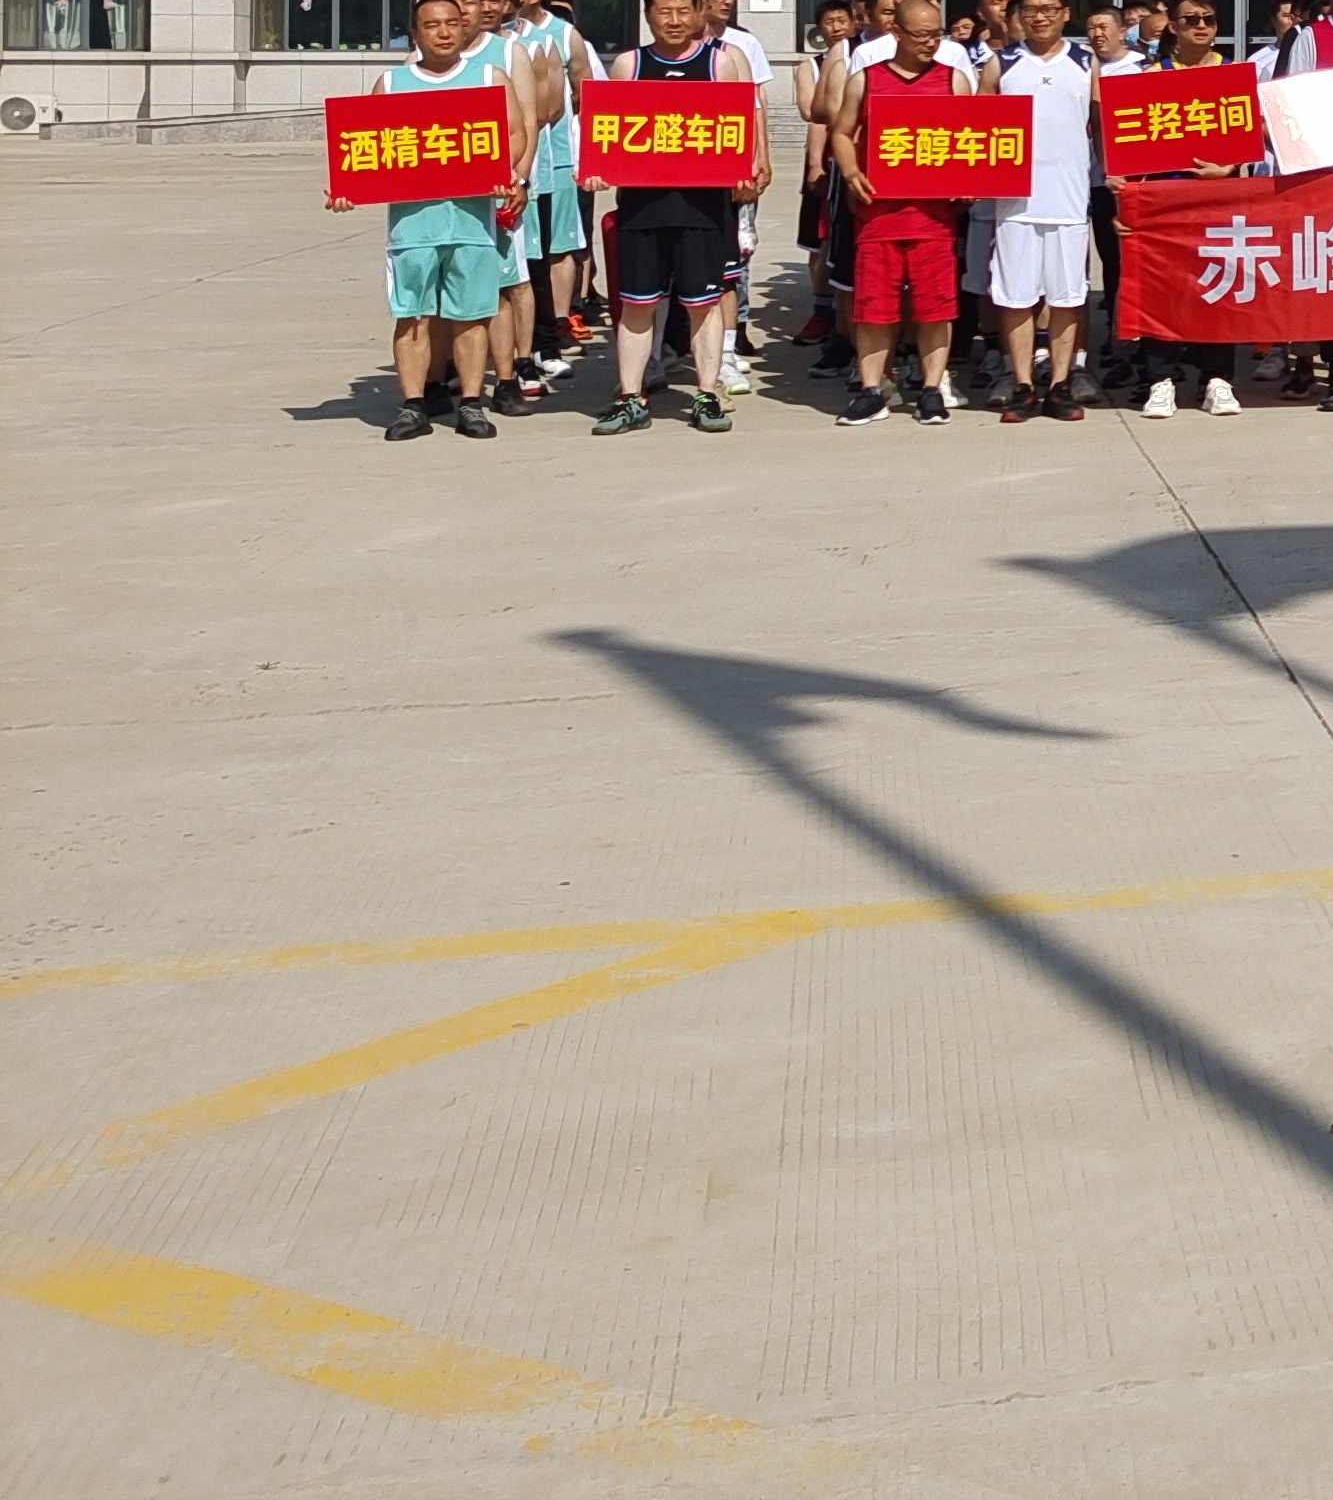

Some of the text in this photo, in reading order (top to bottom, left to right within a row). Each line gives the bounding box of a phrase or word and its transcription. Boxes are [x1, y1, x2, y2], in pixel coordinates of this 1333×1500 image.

[1113, 95, 1254, 144] 三羟车间
[340, 121, 500, 172] 酒精车间
[878, 126, 1025, 167] 季醇车间
